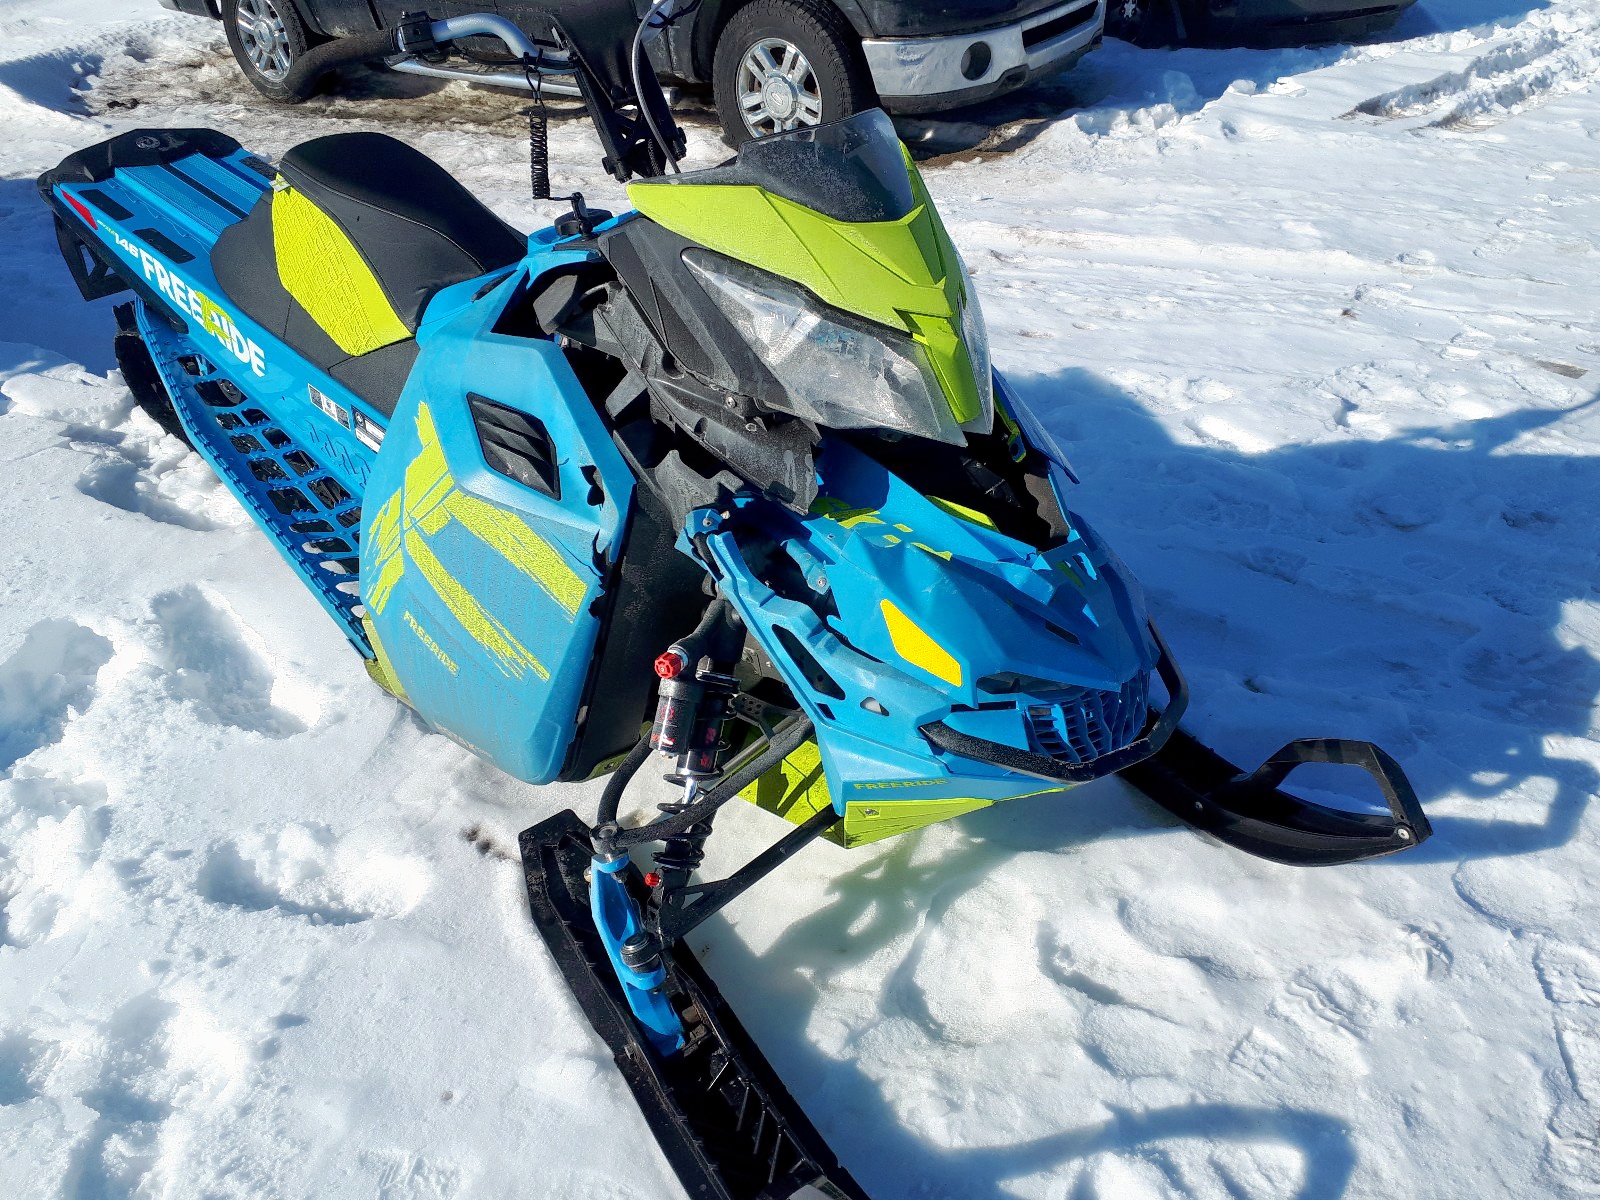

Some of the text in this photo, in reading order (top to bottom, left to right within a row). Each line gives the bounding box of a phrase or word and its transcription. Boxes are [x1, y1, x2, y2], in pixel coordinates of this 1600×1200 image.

[115, 232, 266, 377] 146 FREERIDE
[403, 610, 459, 676] FREERIDE
[853, 778, 948, 790] FREERIDE
